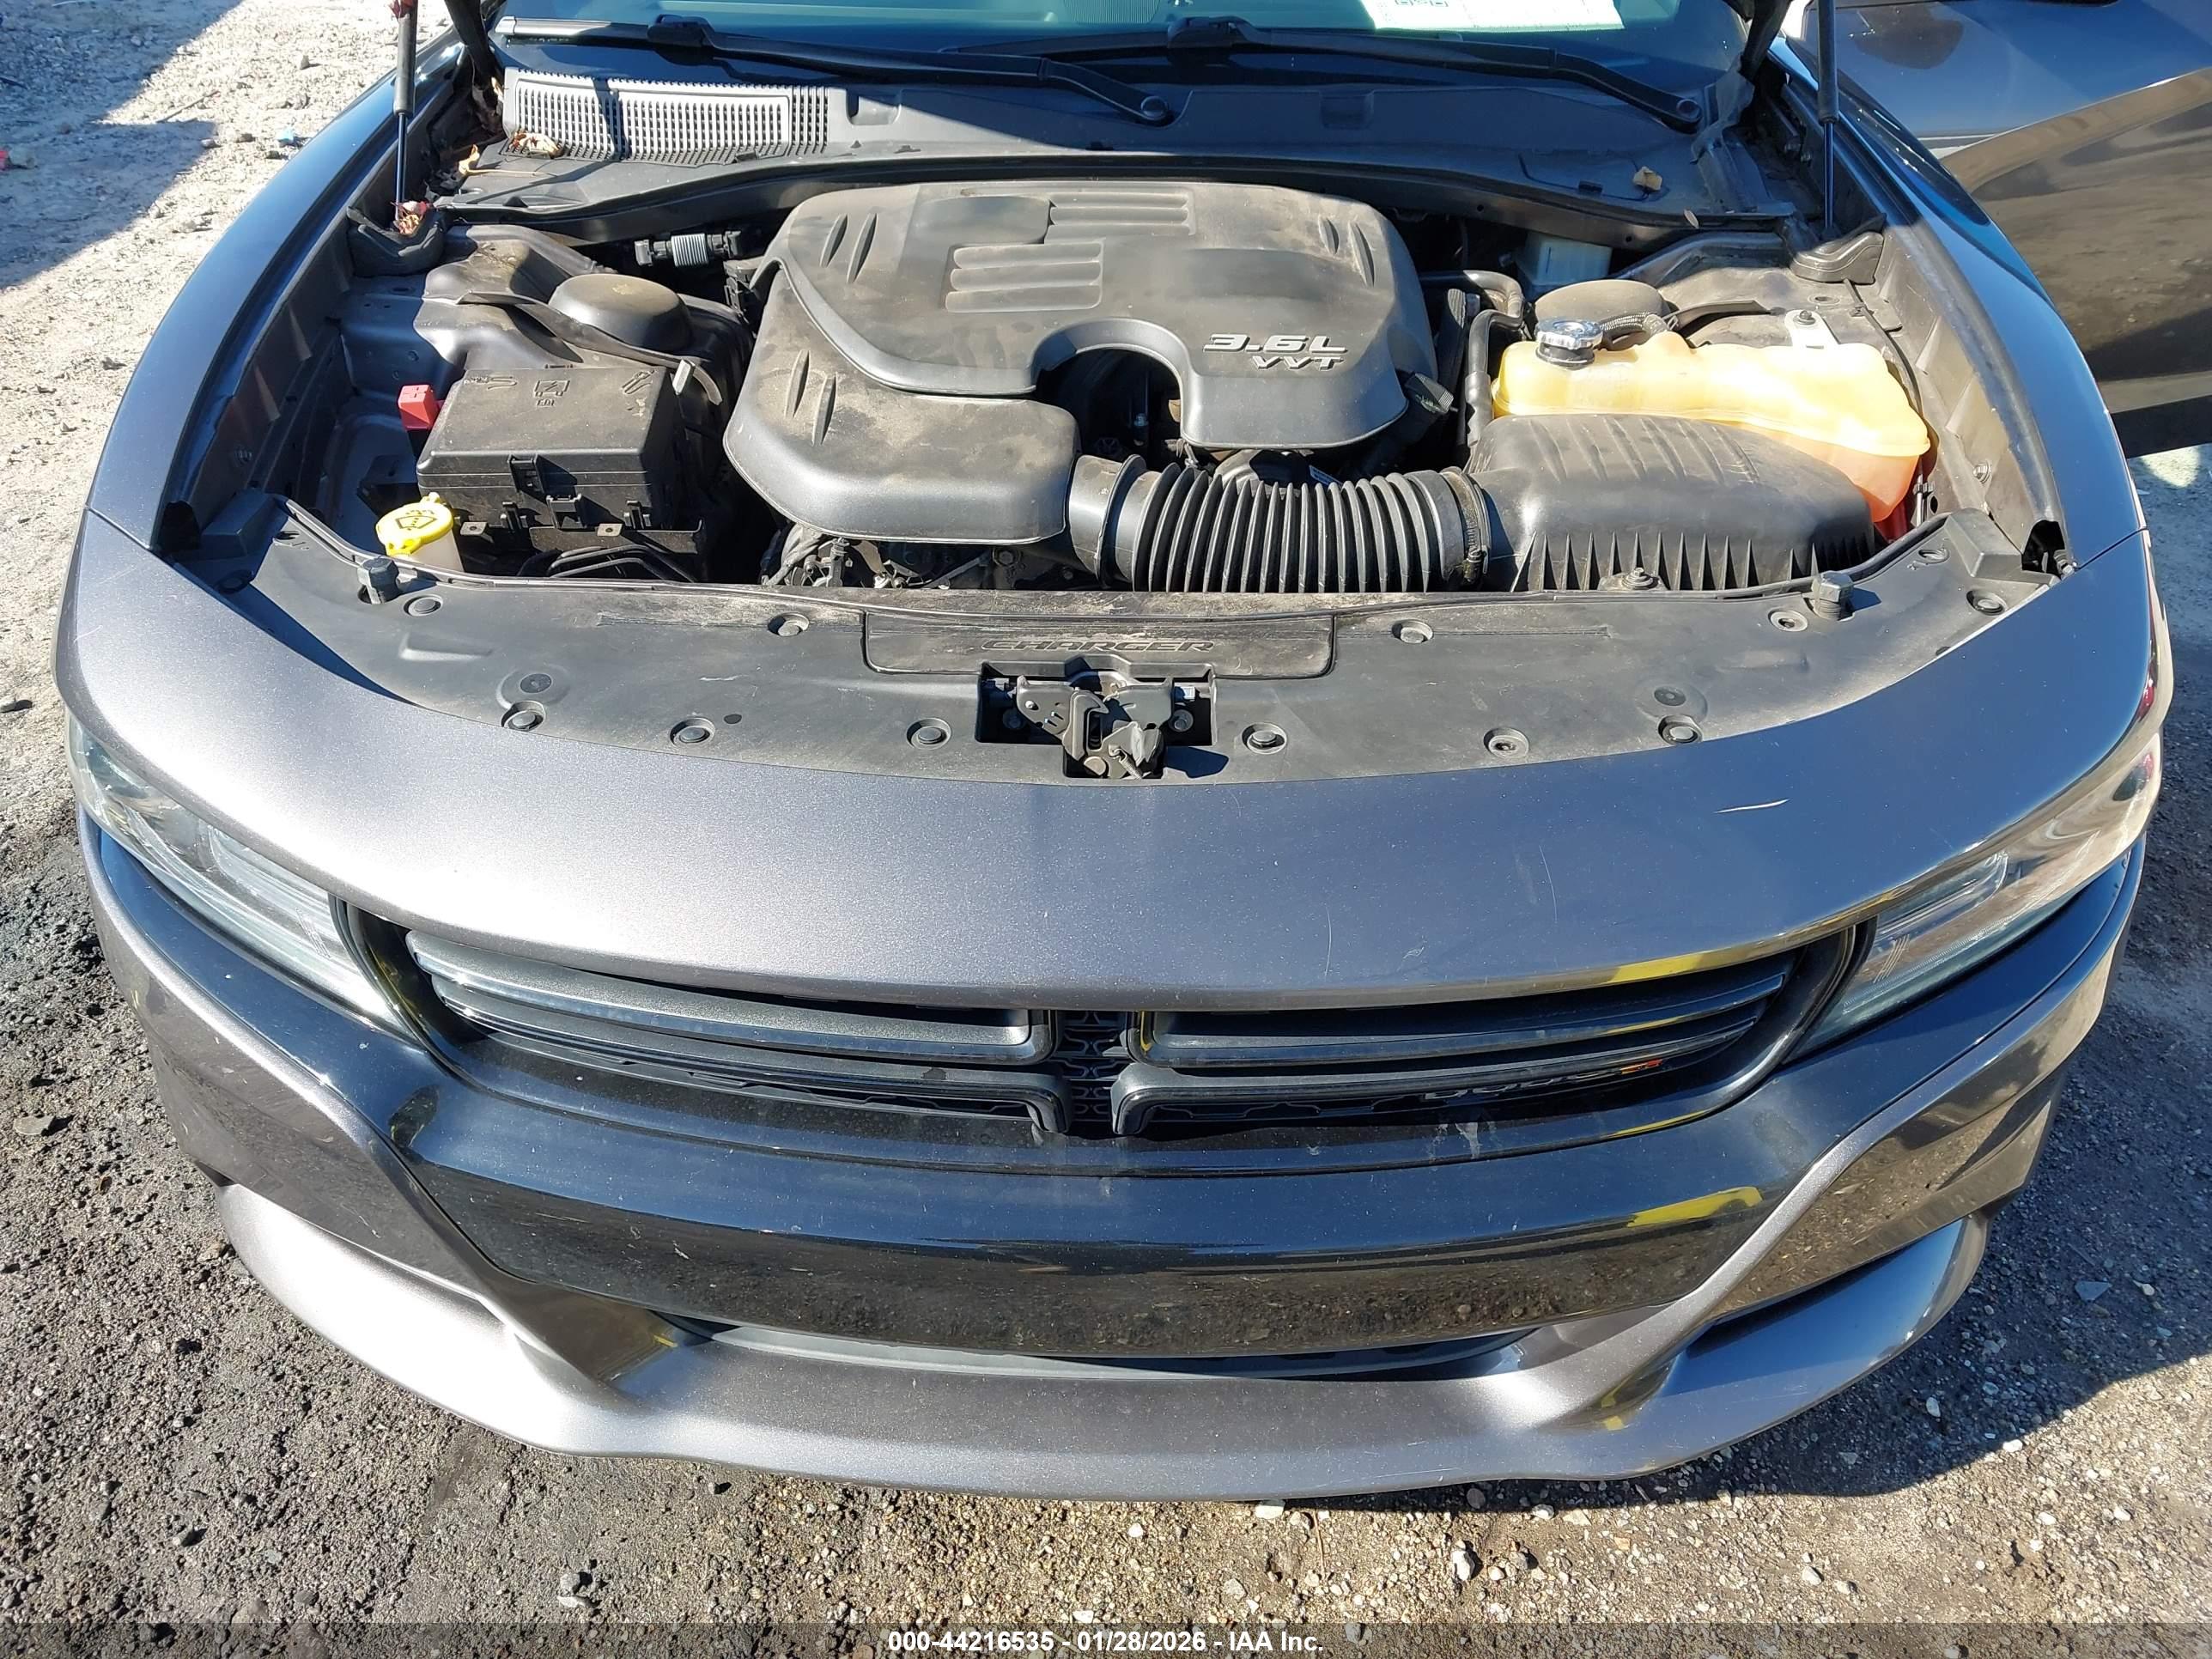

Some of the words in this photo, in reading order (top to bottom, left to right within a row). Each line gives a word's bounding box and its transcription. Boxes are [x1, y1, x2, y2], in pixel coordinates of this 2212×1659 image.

[1203, 334, 1346, 353] 3.6L
[1250, 356, 1343, 370] VVT
[981, 640, 1214, 652] CHARGER
